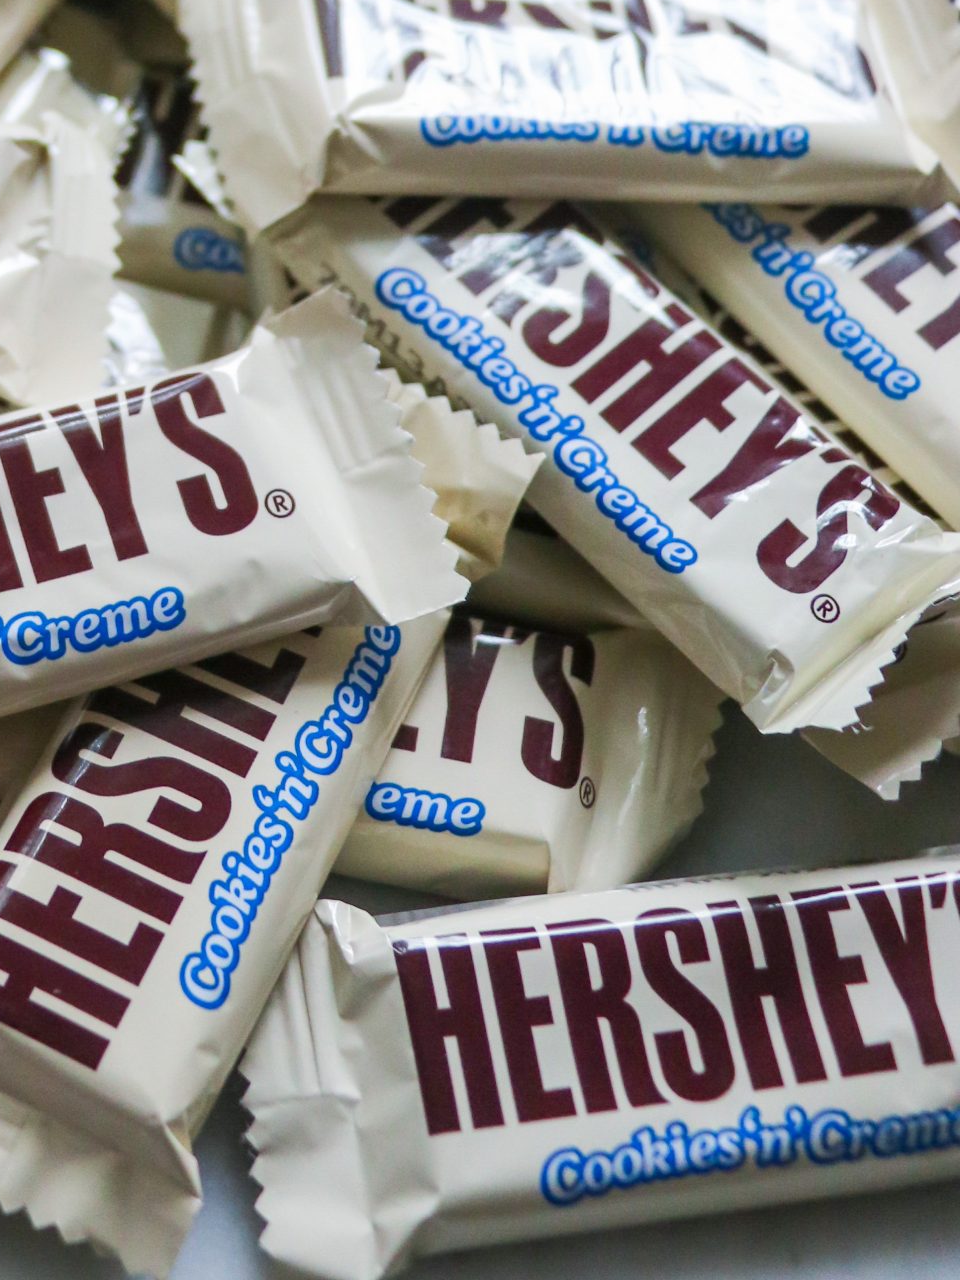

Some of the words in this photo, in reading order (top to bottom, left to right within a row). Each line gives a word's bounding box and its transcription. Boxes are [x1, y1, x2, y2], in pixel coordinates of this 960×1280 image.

[700, 200, 922, 401] es'n'Creme
[375, 265, 699, 574] Cookies'n'Creme
[391, 870, 960, 1138] HERSHEY'
[540, 1102, 960, 1207] Cookies'n'Crem
